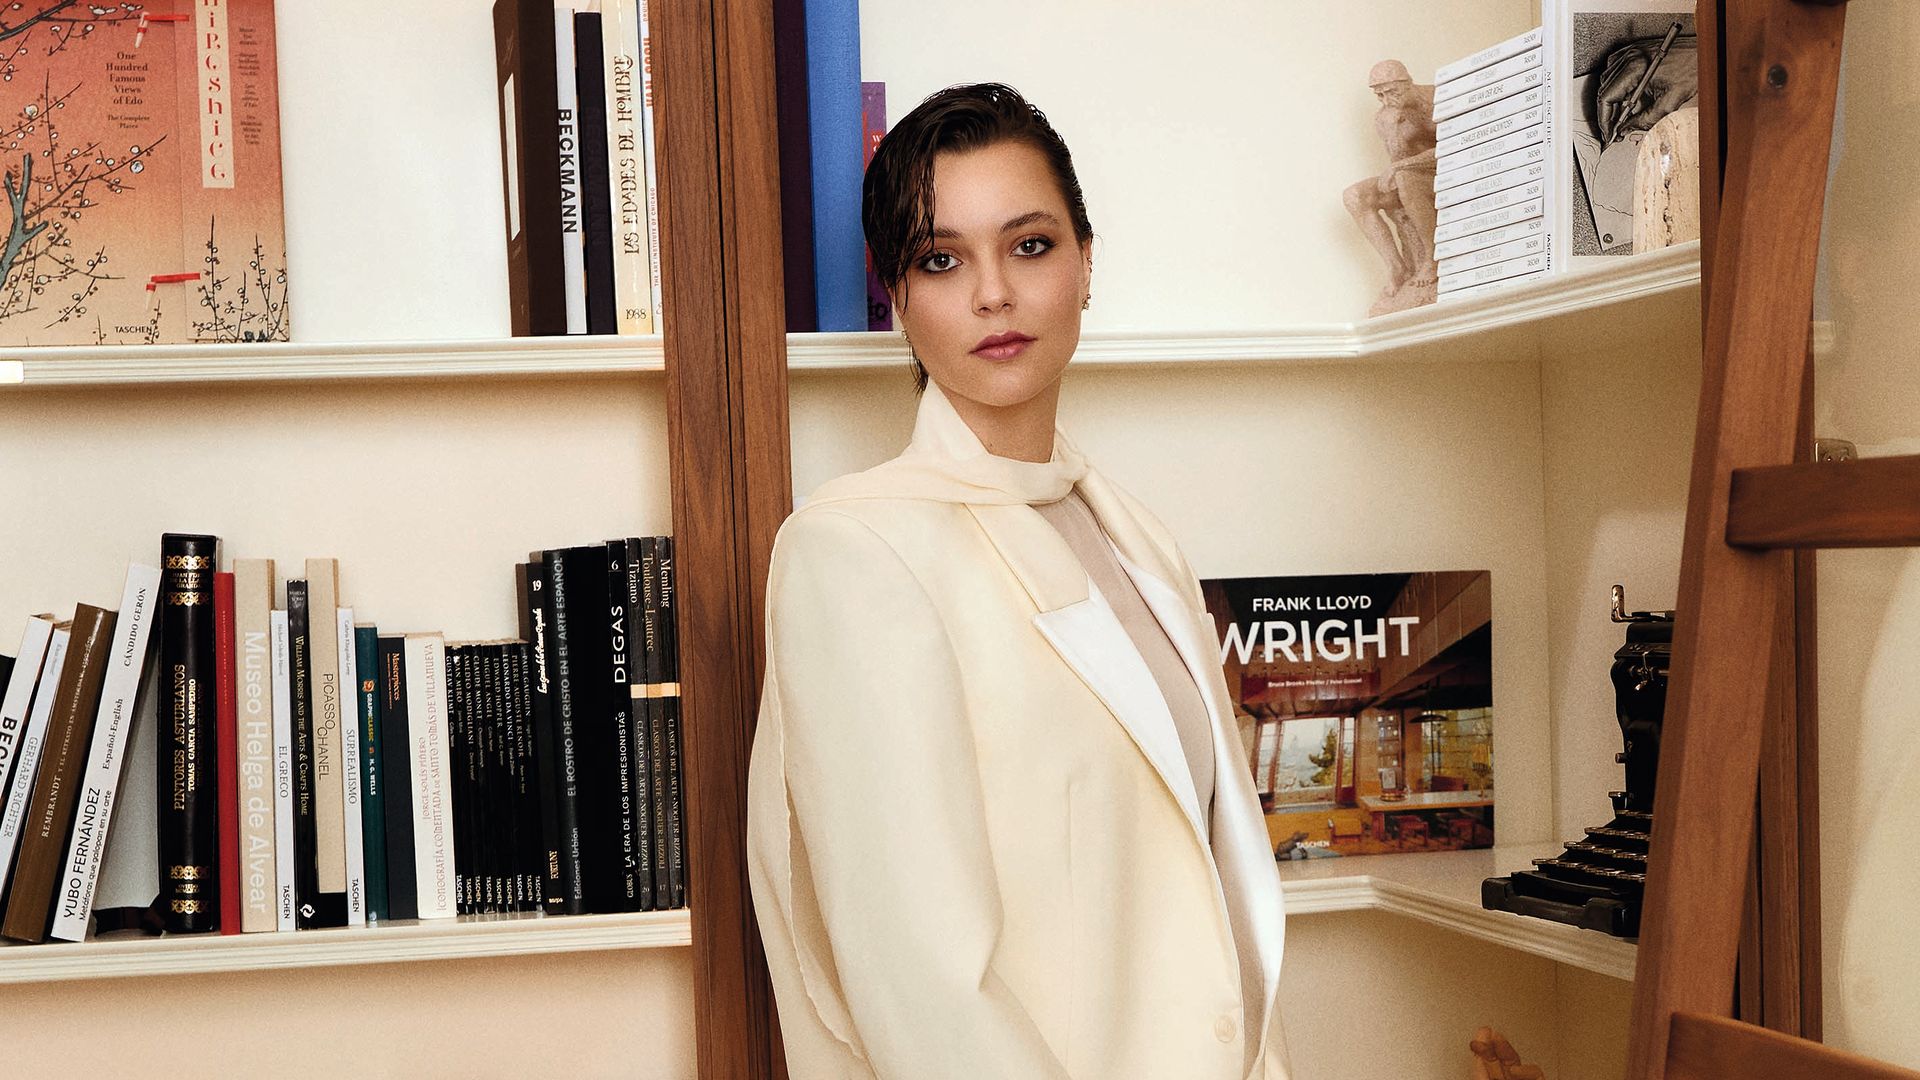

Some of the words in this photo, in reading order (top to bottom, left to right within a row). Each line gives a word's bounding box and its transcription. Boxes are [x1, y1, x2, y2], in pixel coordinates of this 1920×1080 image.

[106, 63, 148, 71] Hundred
[117, 52, 137, 60] One
[109, 73, 146, 82] Famous
[114, 85, 142, 93] Views
[113, 96, 122, 105] of
[125, 96, 143, 105] Edo
[558, 109, 577, 233] BECKMANN
[611, 560, 619, 571] 6
[628, 559, 640, 604] Tiziano
[532, 580, 542, 592] 19
[552, 557, 565, 609] ESPAÑOL
[660, 558, 672, 609] Memling
[642, 553, 656, 652] Toulouse-Lautrec
[1252, 597, 1311, 612] FRANK
[1316, 595, 1372, 610] LLOYD
[123, 623, 139, 667] CÁNDIDO
[132, 587, 147, 621] GERÓN
[556, 612, 567, 641] ARTE
[1219, 616, 1420, 666] WRIGHT
[558, 644, 568, 657] EL
[611, 605, 626, 683] DEGAS
[245, 632, 266, 714] Museo
[391, 653, 401, 702] Masterpieces
[424, 643, 435, 700] VILLANUEVA
[446, 655, 454, 687] GUSTAV
[464, 654, 472, 689] AMEDEO
[473, 655, 481, 688] CLAUDE
[483, 657, 492, 689] MIGUEL
[493, 657, 502, 693] EDWARD
[502, 653, 511, 700] LEONARDO
[521, 655, 529, 675] PAUL
[559, 660, 569, 675] EN
[174, 664, 185, 745] ASTURIANOS
[188, 678, 196, 725] SAMPEDRO
[323, 673, 336, 729] PICASSO
[475, 690, 483, 720] MONET
[485, 691, 493, 719] ANGEL
[511, 654, 523, 723] PIERRE-AUGUSTE
[523, 676, 531, 717] GAUGUIN
[560, 679, 572, 718] CRISTO
[427, 700, 436, 713] DE
[465, 691, 474, 745] MODIGLIANI
[495, 695, 503, 728] HOPPER
[505, 701, 512, 714] DA
[102, 698, 123, 770] Español-English
[506, 715, 514, 740] VINCI
[516, 725, 524, 758] RENOIR
[563, 720, 573, 735] DE
[652, 719, 661, 758] CLASICOS
[667, 718, 677, 756] CLASICOS
[187, 728, 195, 761] GARCIA
[242, 721, 269, 790] Helga
[279, 746, 288, 759] EL
[299, 753, 308, 761] &
[317, 727, 330, 781] CHANEL
[564, 738, 576, 782] ROSTRO
[617, 711, 628, 793] IMPRESIONISTAS
[17, 736, 38, 789] GERHARD
[187, 762, 195, 792] TOMAS
[346, 729, 359, 804] SURREALISMO
[430, 748, 440, 778] SANTO
[638, 759, 646, 774] DEL
[174, 750, 185, 810] PINTORES
[279, 761, 289, 798] GRECO
[418, 769, 429, 793] SOLÍS
[566, 785, 577, 797] EL
[639, 776, 647, 798] ARTE
[670, 775, 678, 796] ARTE
[3, 791, 24, 838] RICHTER
[41, 775, 62, 837] REMBRANDT
[103, 790, 112, 807] arte
[248, 797, 271, 829] de
[422, 794, 431, 820] JORGE
[621, 795, 629, 814] LOS
[72, 786, 100, 874] FERNÁNDEZ
[99, 818, 106, 829] en
[622, 818, 630, 831] DE
[92, 831, 104, 862] galopan
[623, 833, 632, 853] ERA
[1296, 840, 1330, 849] TASCHEN
[88, 864, 97, 880] que
[249, 835, 272, 913] Alvear
[549, 850, 559, 880] FORTUNY
[624, 855, 632, 868] LA
[351, 878, 361, 913] TASCHEN
[465, 878, 473, 905] TASCHEN
[573, 859, 582, 900] Ediciones
[626, 873, 634, 898] GLOBUS
[64, 877, 81, 918] YUBO
[79, 881, 93, 921] Metáforas
[283, 884, 291, 919] TASCHEN
